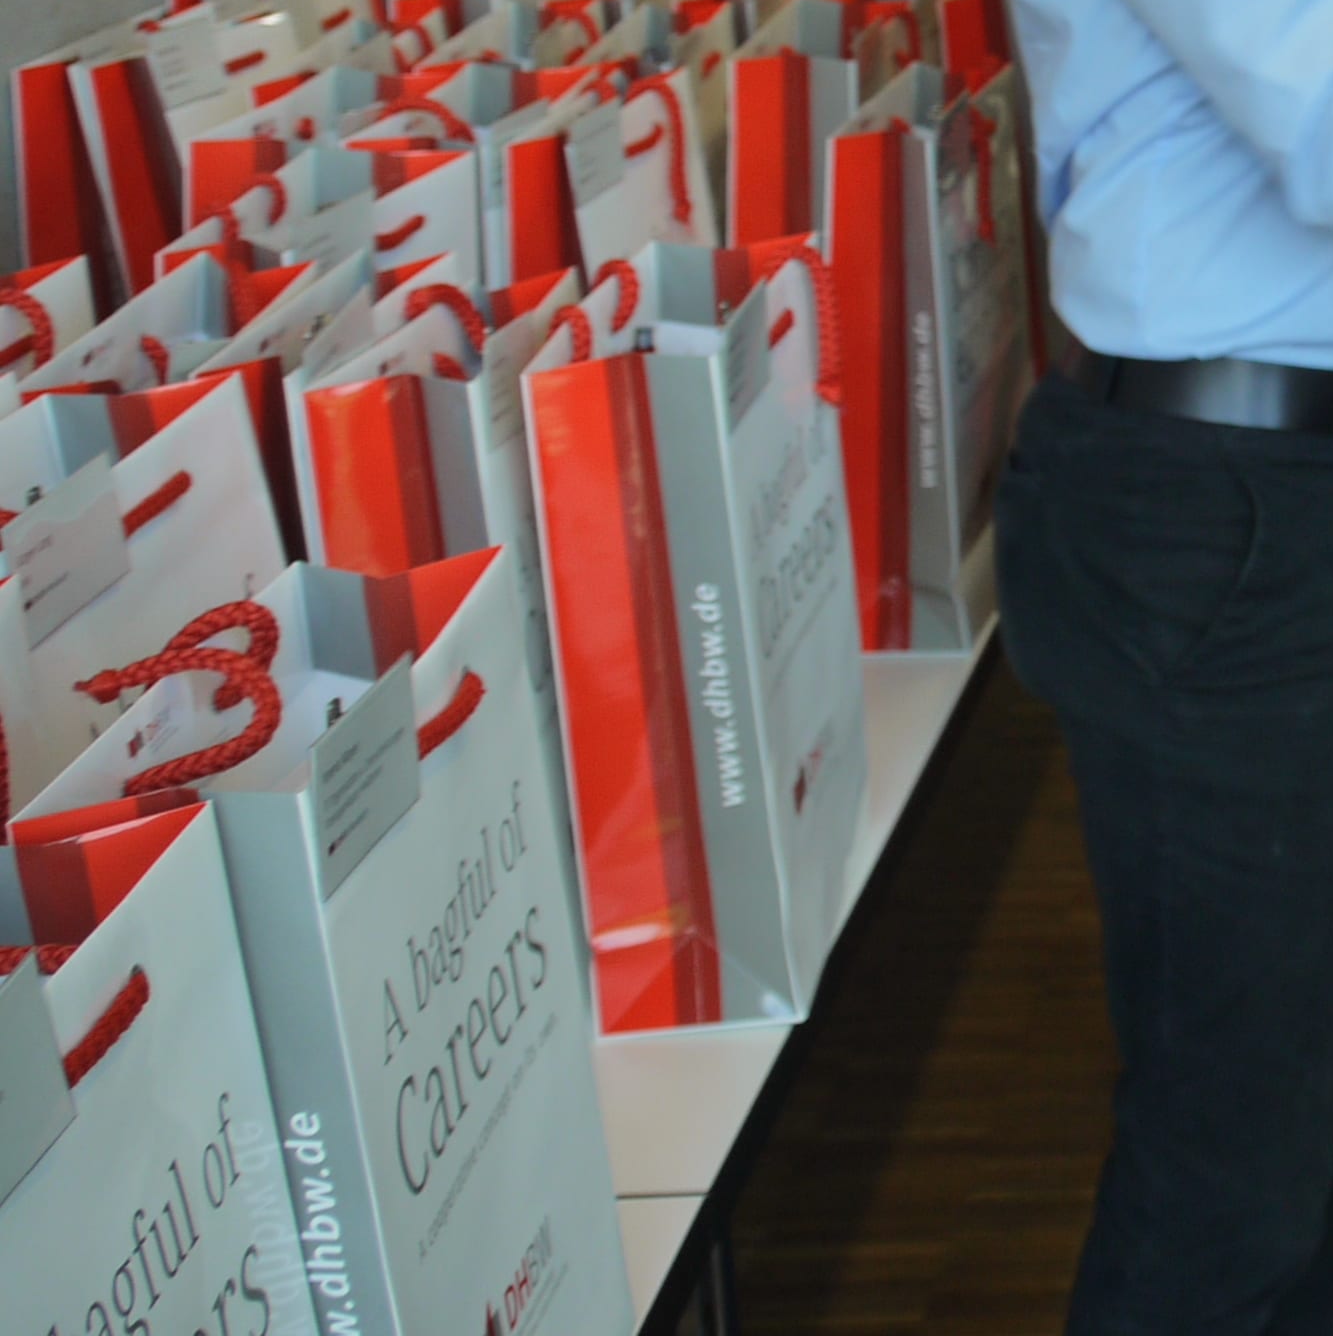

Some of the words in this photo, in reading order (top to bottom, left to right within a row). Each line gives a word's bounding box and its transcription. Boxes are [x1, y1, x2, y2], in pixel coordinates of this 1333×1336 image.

[691, 581, 746, 809] www.dhbw.de
[383, 976, 409, 1067] A
[406, 824, 497, 1014] bagful
[500, 778, 528, 873] of
[203, 1090, 241, 1209] of
[396, 904, 548, 1196] Careers
[503, 1214, 554, 1331] DHBW
